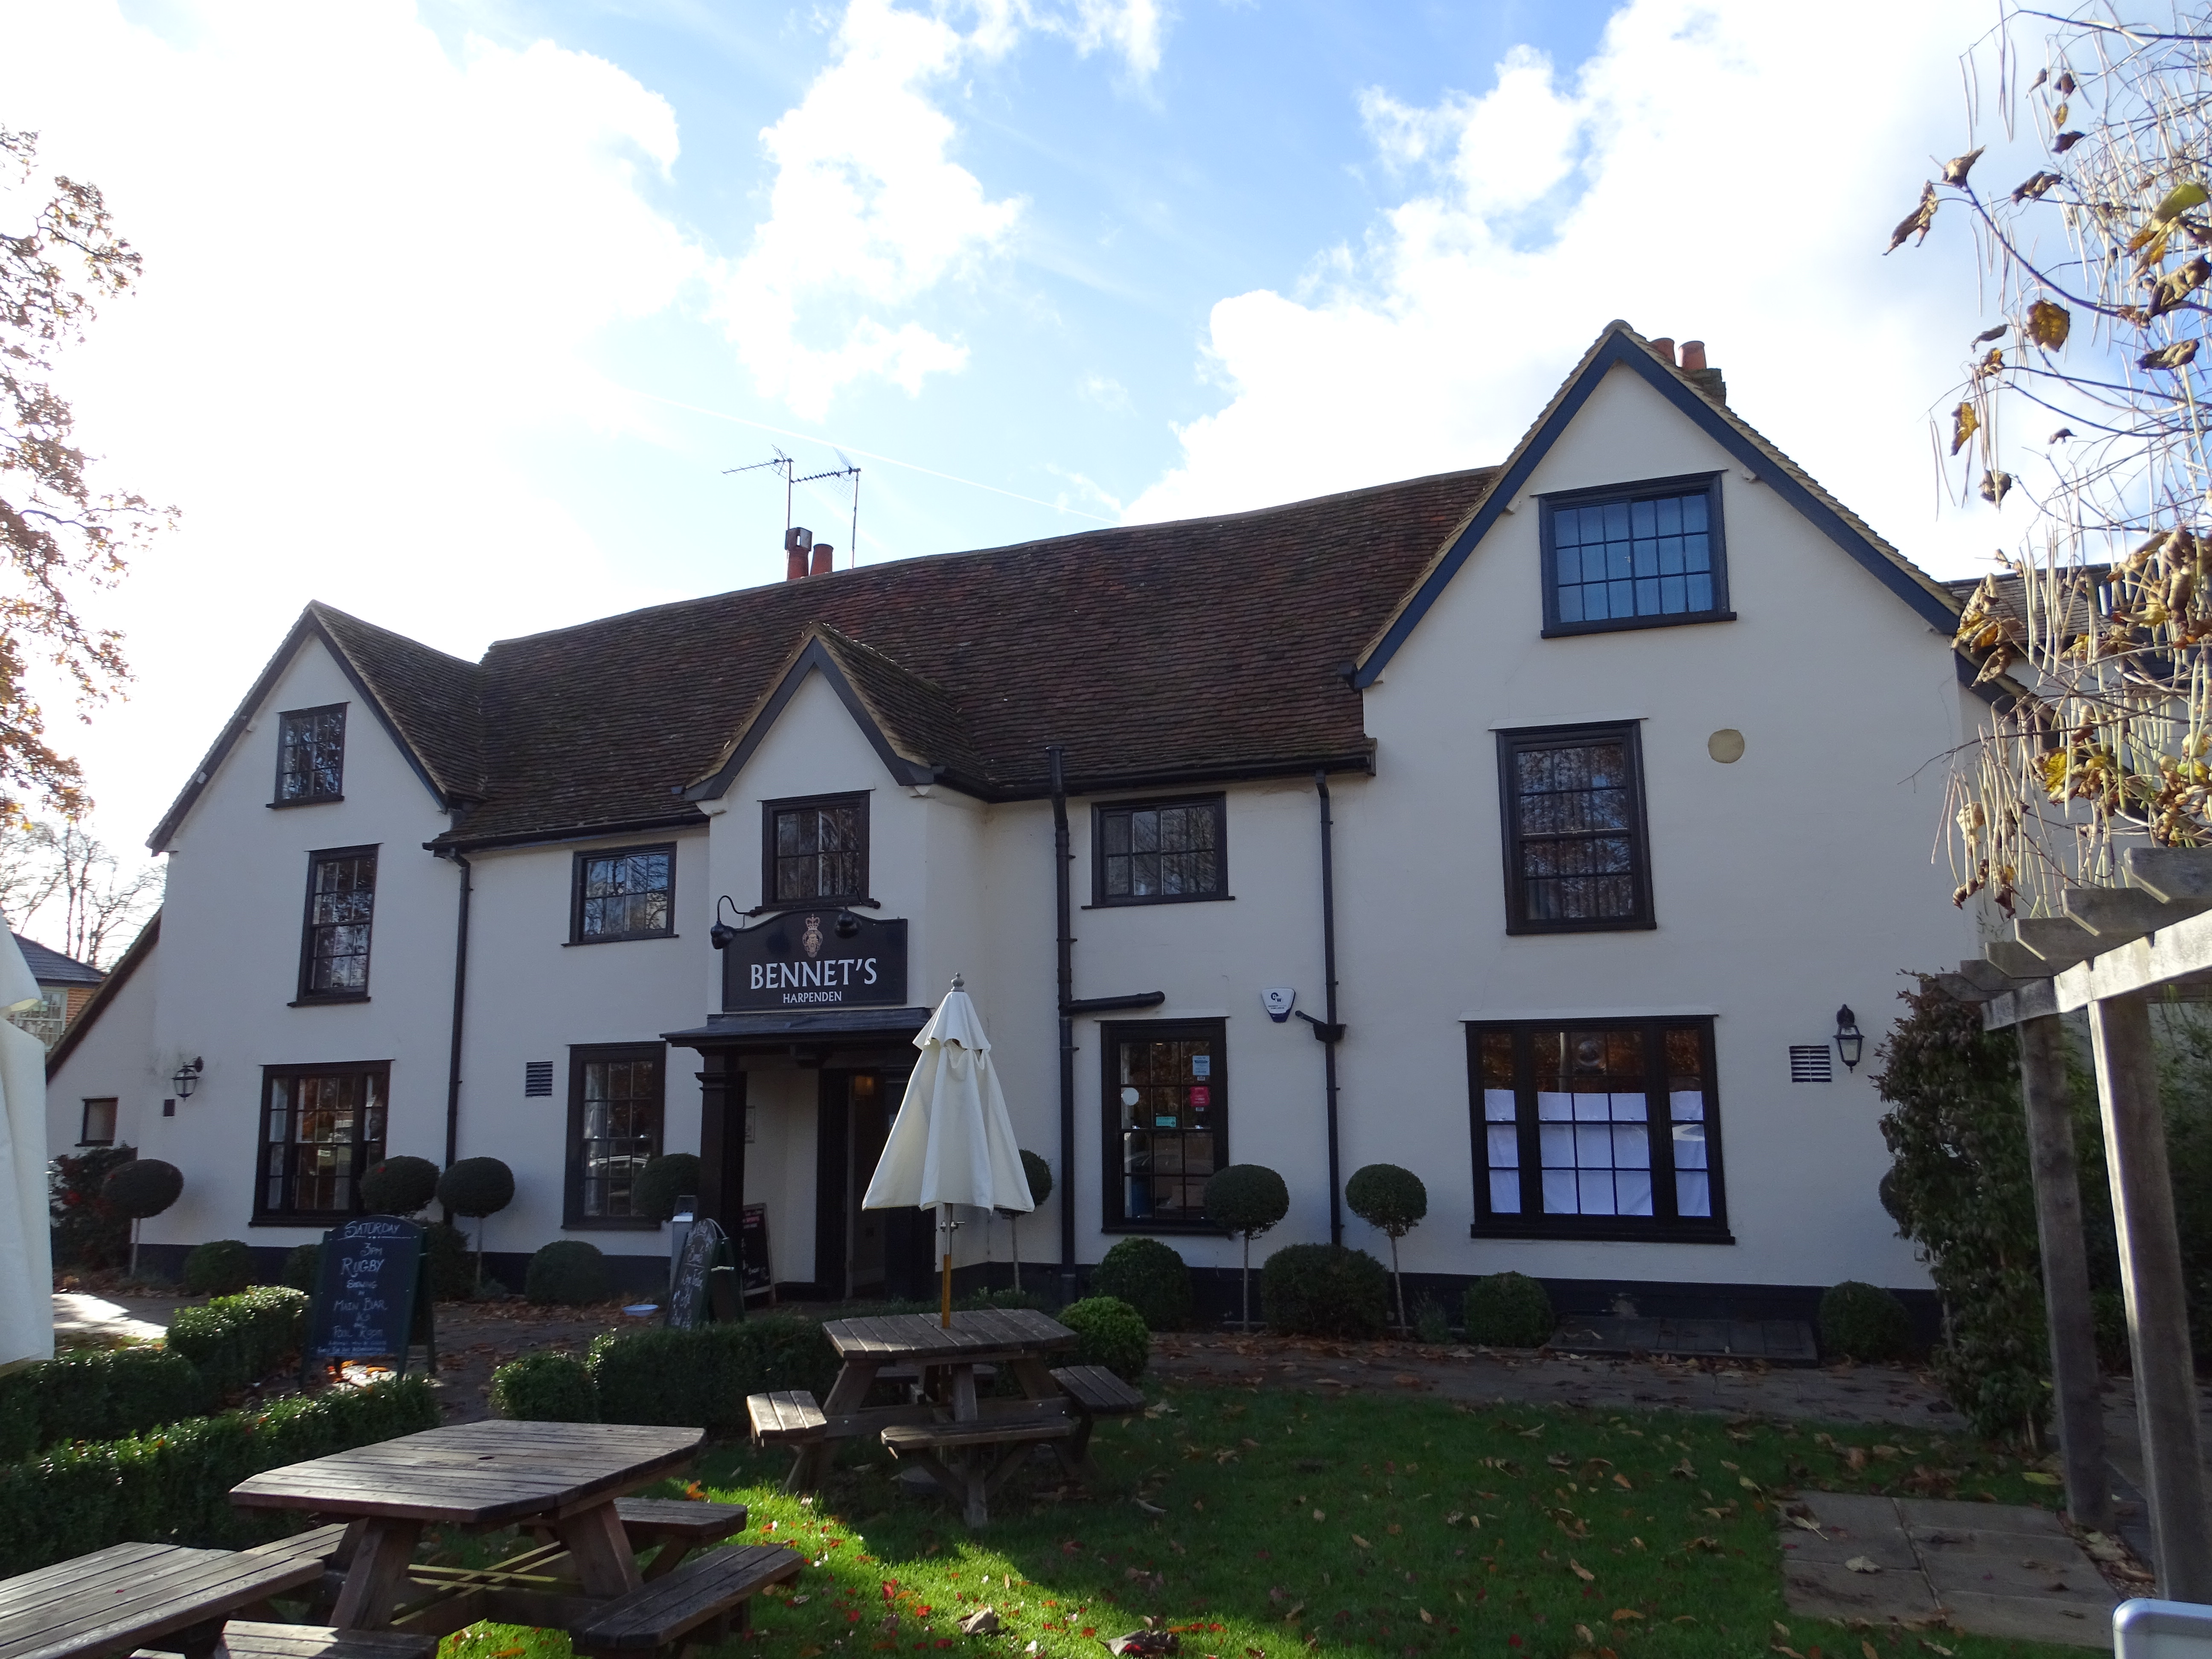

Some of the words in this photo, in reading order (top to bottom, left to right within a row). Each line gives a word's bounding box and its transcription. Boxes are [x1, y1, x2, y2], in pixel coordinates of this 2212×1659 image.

[750, 958, 877, 989] BENNET'S
[783, 991, 842, 1003] HARPENDEN
[344, 1220, 401, 1237] SATURDAY
[341, 1257, 385, 1277] RUGBY
